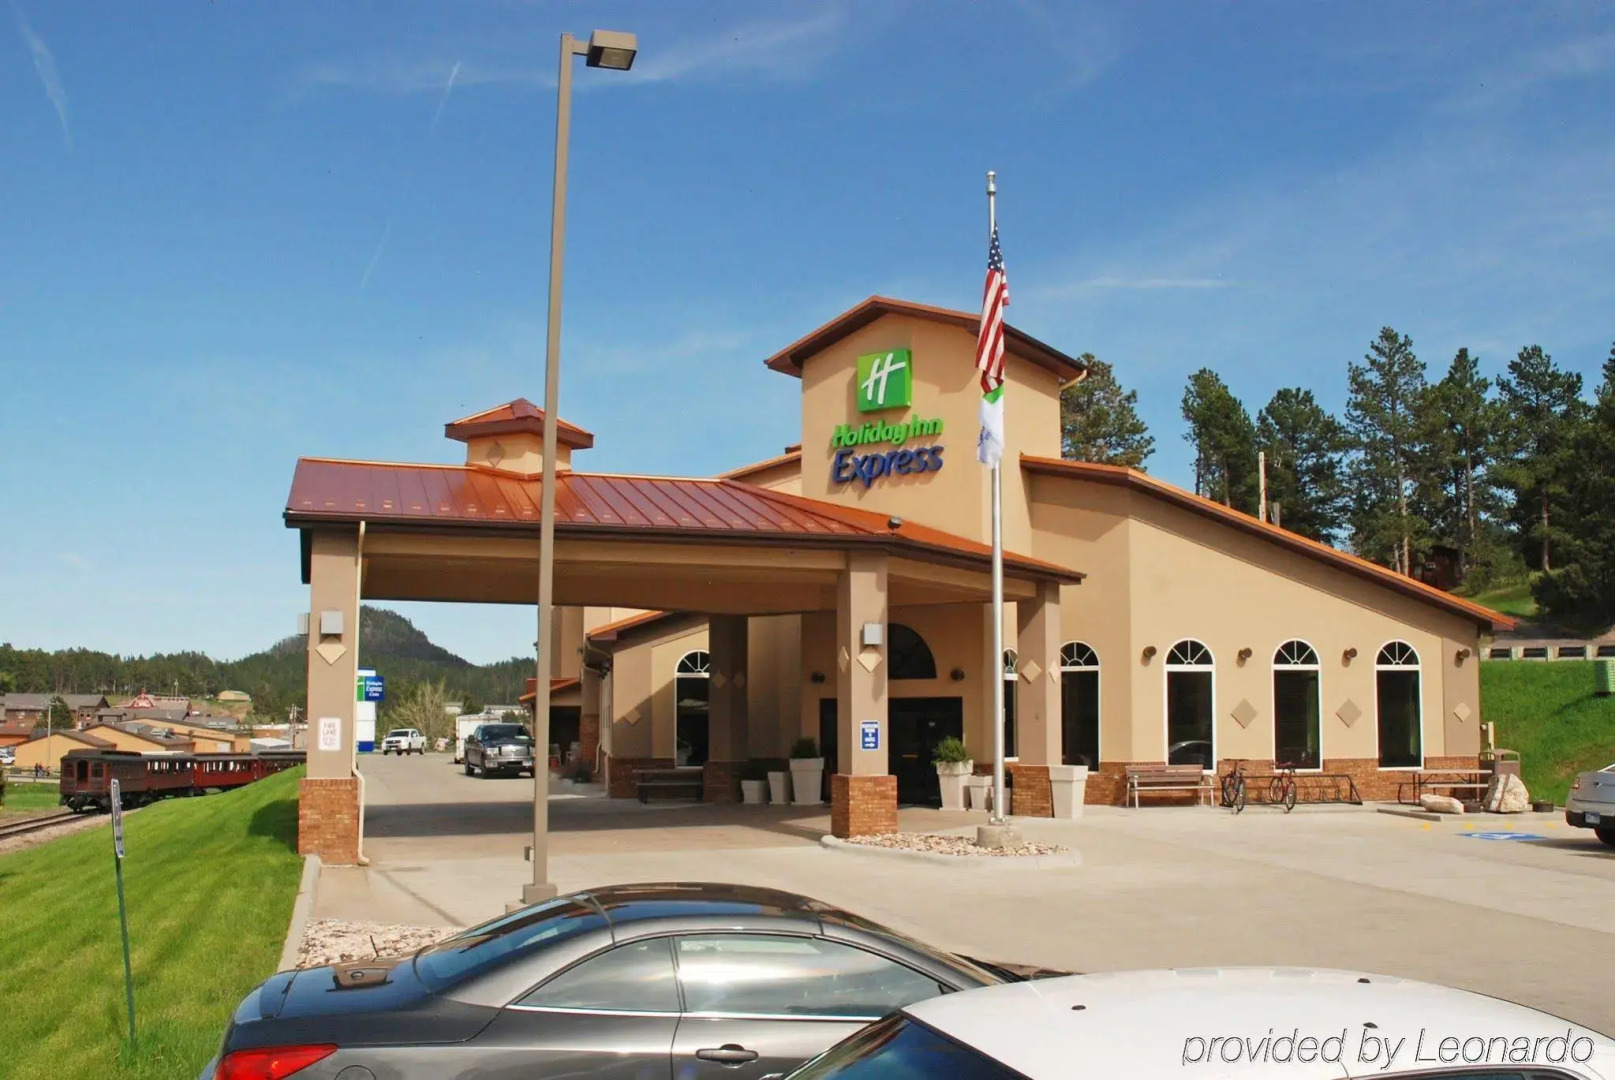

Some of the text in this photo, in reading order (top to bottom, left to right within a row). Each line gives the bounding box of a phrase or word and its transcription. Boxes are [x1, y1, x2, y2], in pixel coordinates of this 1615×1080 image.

[861, 353, 906, 405] H
[832, 414, 944, 448] Holiday Inn
[833, 445, 944, 488] Express
